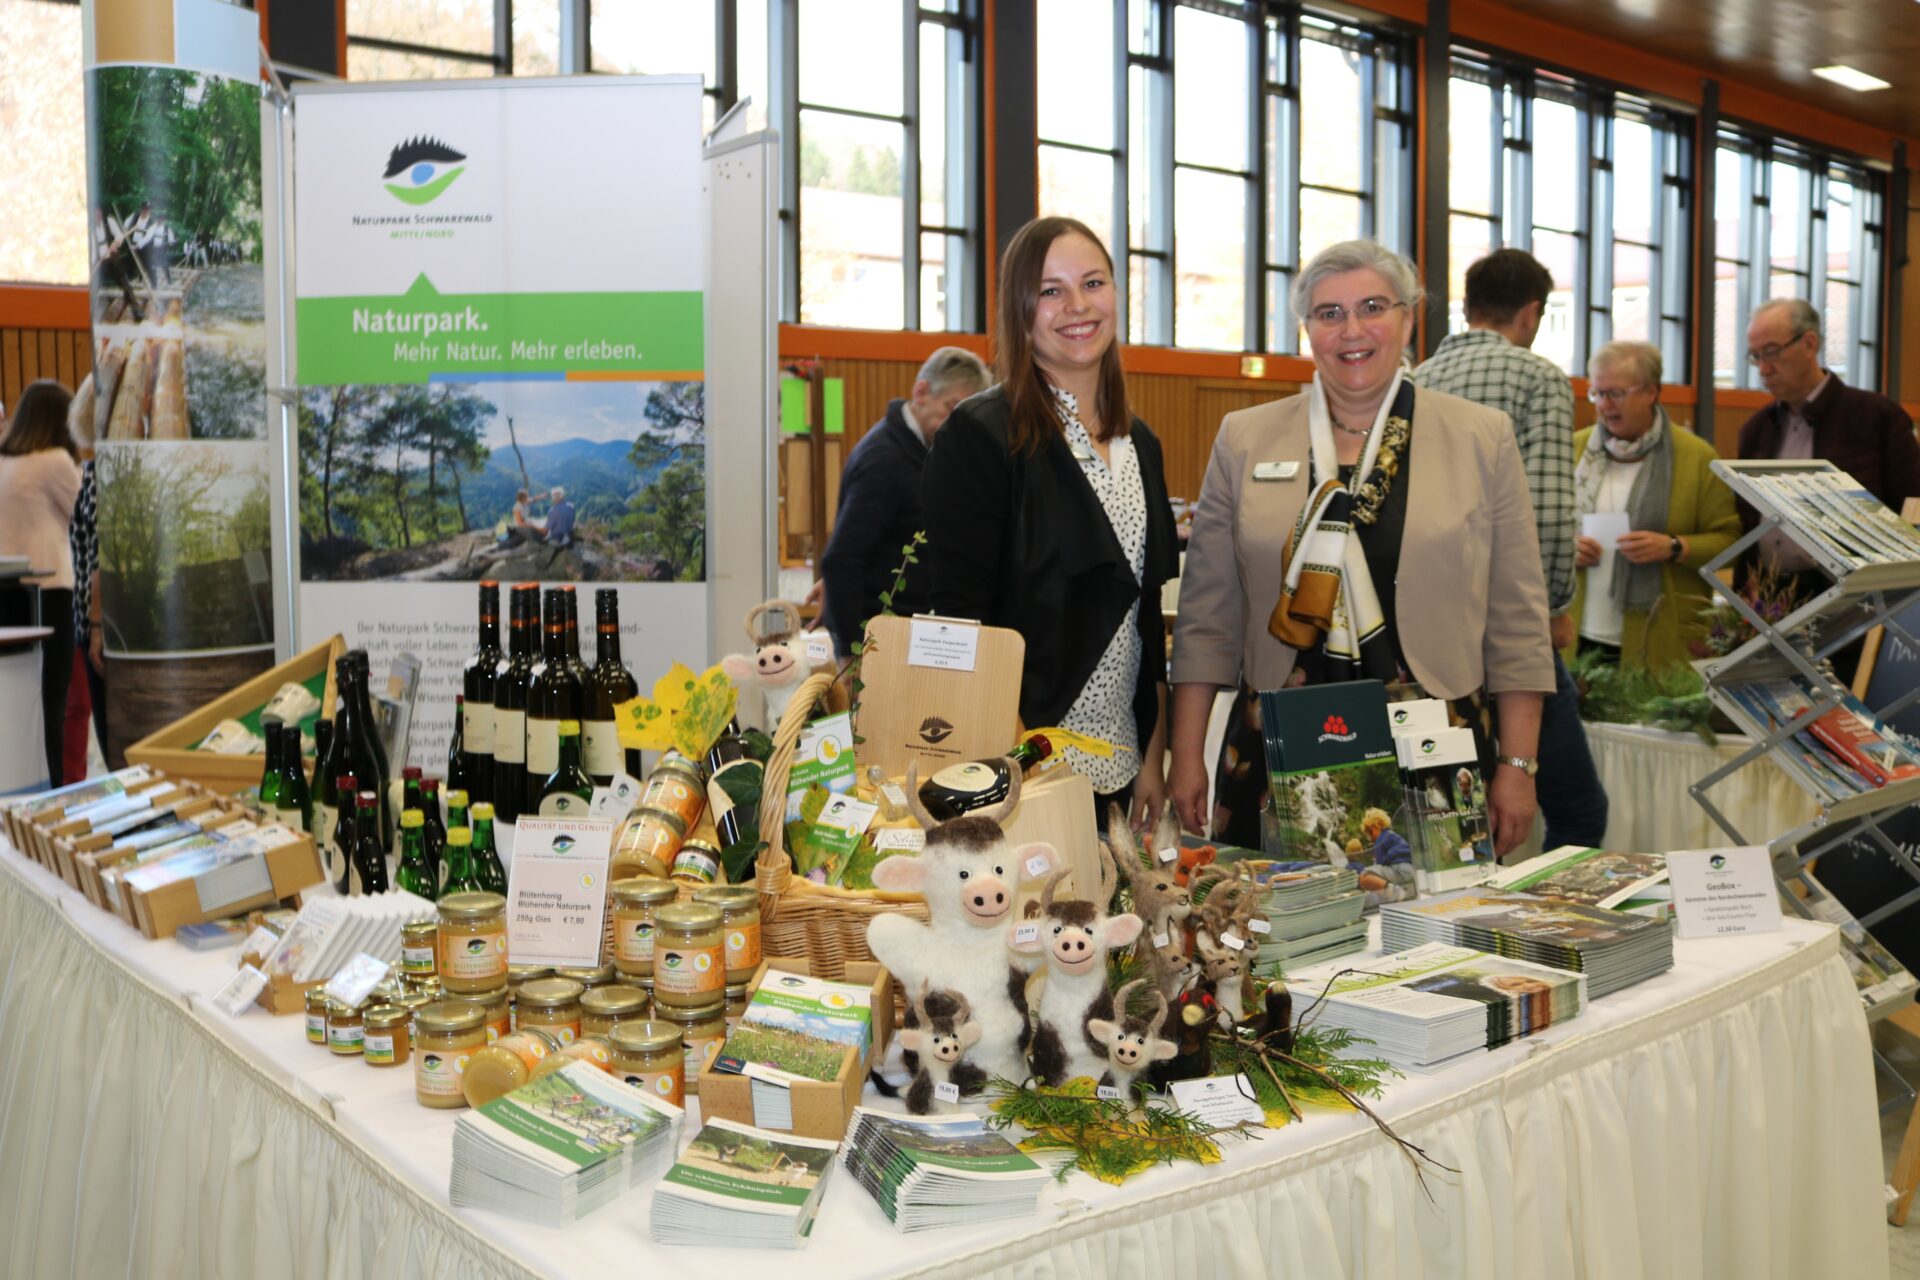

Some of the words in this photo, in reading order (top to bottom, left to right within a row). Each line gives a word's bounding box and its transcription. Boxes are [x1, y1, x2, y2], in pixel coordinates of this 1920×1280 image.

[352, 215, 412, 226] NATURPARK
[414, 213, 493, 225] SCHWARZWALD
[352, 306, 489, 337] Naturpark.
[393, 342, 440, 362] Mehr
[446, 342, 503, 361] Natur.
[510, 340, 558, 361] Mehr
[564, 340, 643, 361] erleben.
[357, 622, 375, 634] Der
[378, 622, 429, 636] Naturpark
[433, 622, 480, 634] Schwarz
[393, 639, 422, 651] voller
[426, 639, 458, 651] Leben
[519, 821, 556, 832] QUALITÄT
[558, 823, 577, 832] UND
[1706, 882, 1736, 891] GeoBox
[519, 890, 562, 901] Blütenhonig
[517, 901, 554, 910] Blühender
[556, 902, 592, 912] Naturpark
[516, 914, 533, 924] 250g
[535, 914, 551, 923] Glas
[563, 916, 569, 924] €
